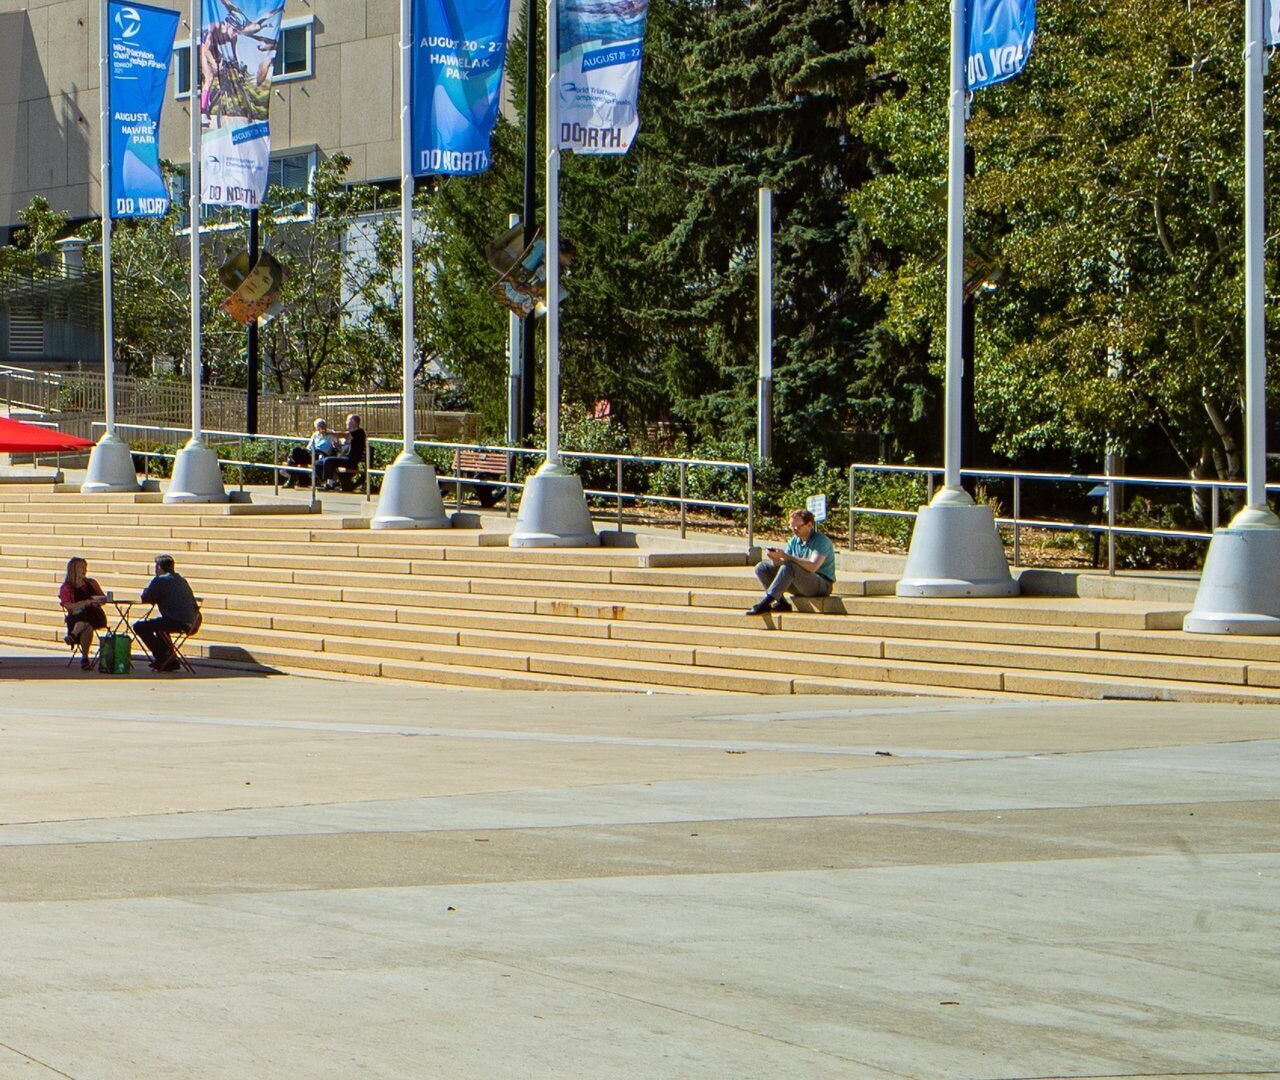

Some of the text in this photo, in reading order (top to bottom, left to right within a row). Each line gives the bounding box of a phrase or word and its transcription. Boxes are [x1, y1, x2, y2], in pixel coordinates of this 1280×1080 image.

[462, 41, 477, 51] 20
[583, 52, 618, 67] AUGUST
[115, 112, 148, 122] AUGUST
[421, 149, 441, 170] DO
[209, 185, 222, 200] DO
[116, 198, 166, 214] DO NORT
